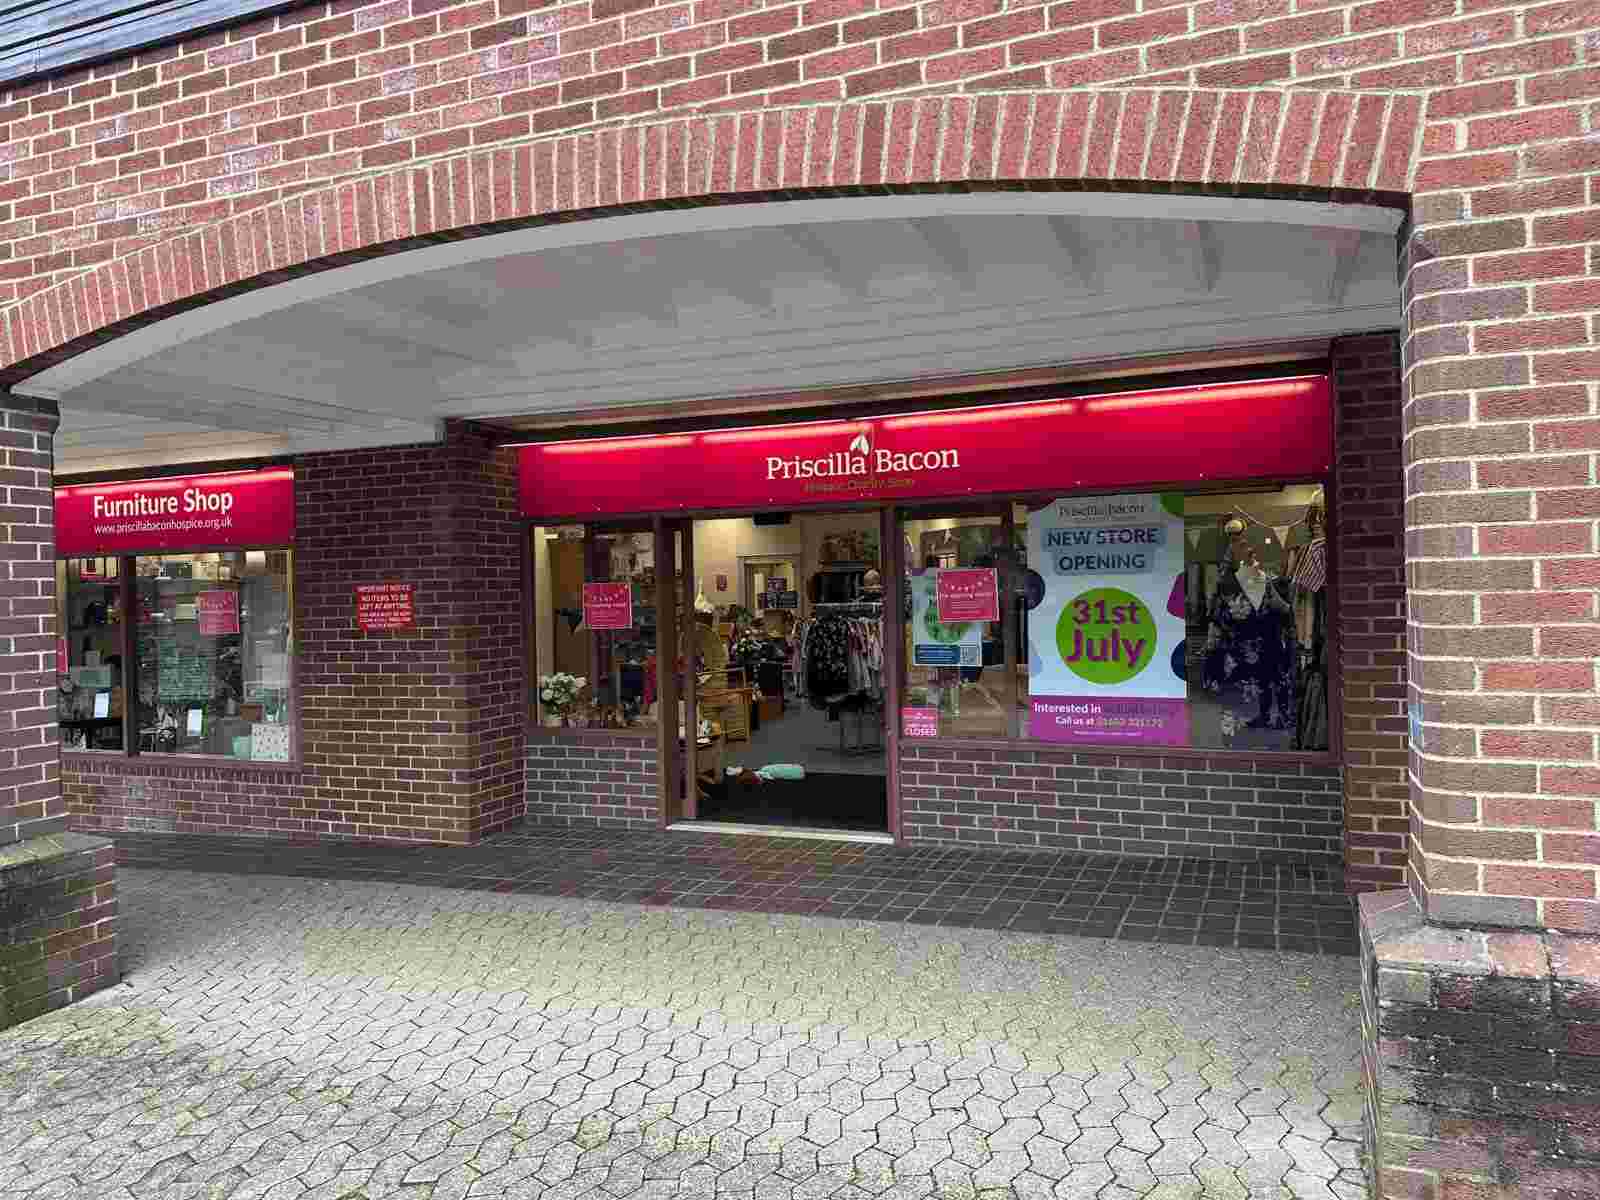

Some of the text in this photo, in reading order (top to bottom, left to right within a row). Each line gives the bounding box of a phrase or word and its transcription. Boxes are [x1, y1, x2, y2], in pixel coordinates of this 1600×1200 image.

[766, 447, 961, 480] Priscilla Bacon
[93, 488, 233, 518] Furniture Shop
[95, 513, 233, 535] www.priscillabaconhospice.org.uk
[1047, 527, 1160, 547] NEW STORE
[1058, 553, 1146, 571] OPENING
[1071, 599, 1140, 625] 31st
[1064, 627, 1147, 669] July
[1033, 702, 1089, 714] Interested
[903, 728, 937, 737] CLOSED
